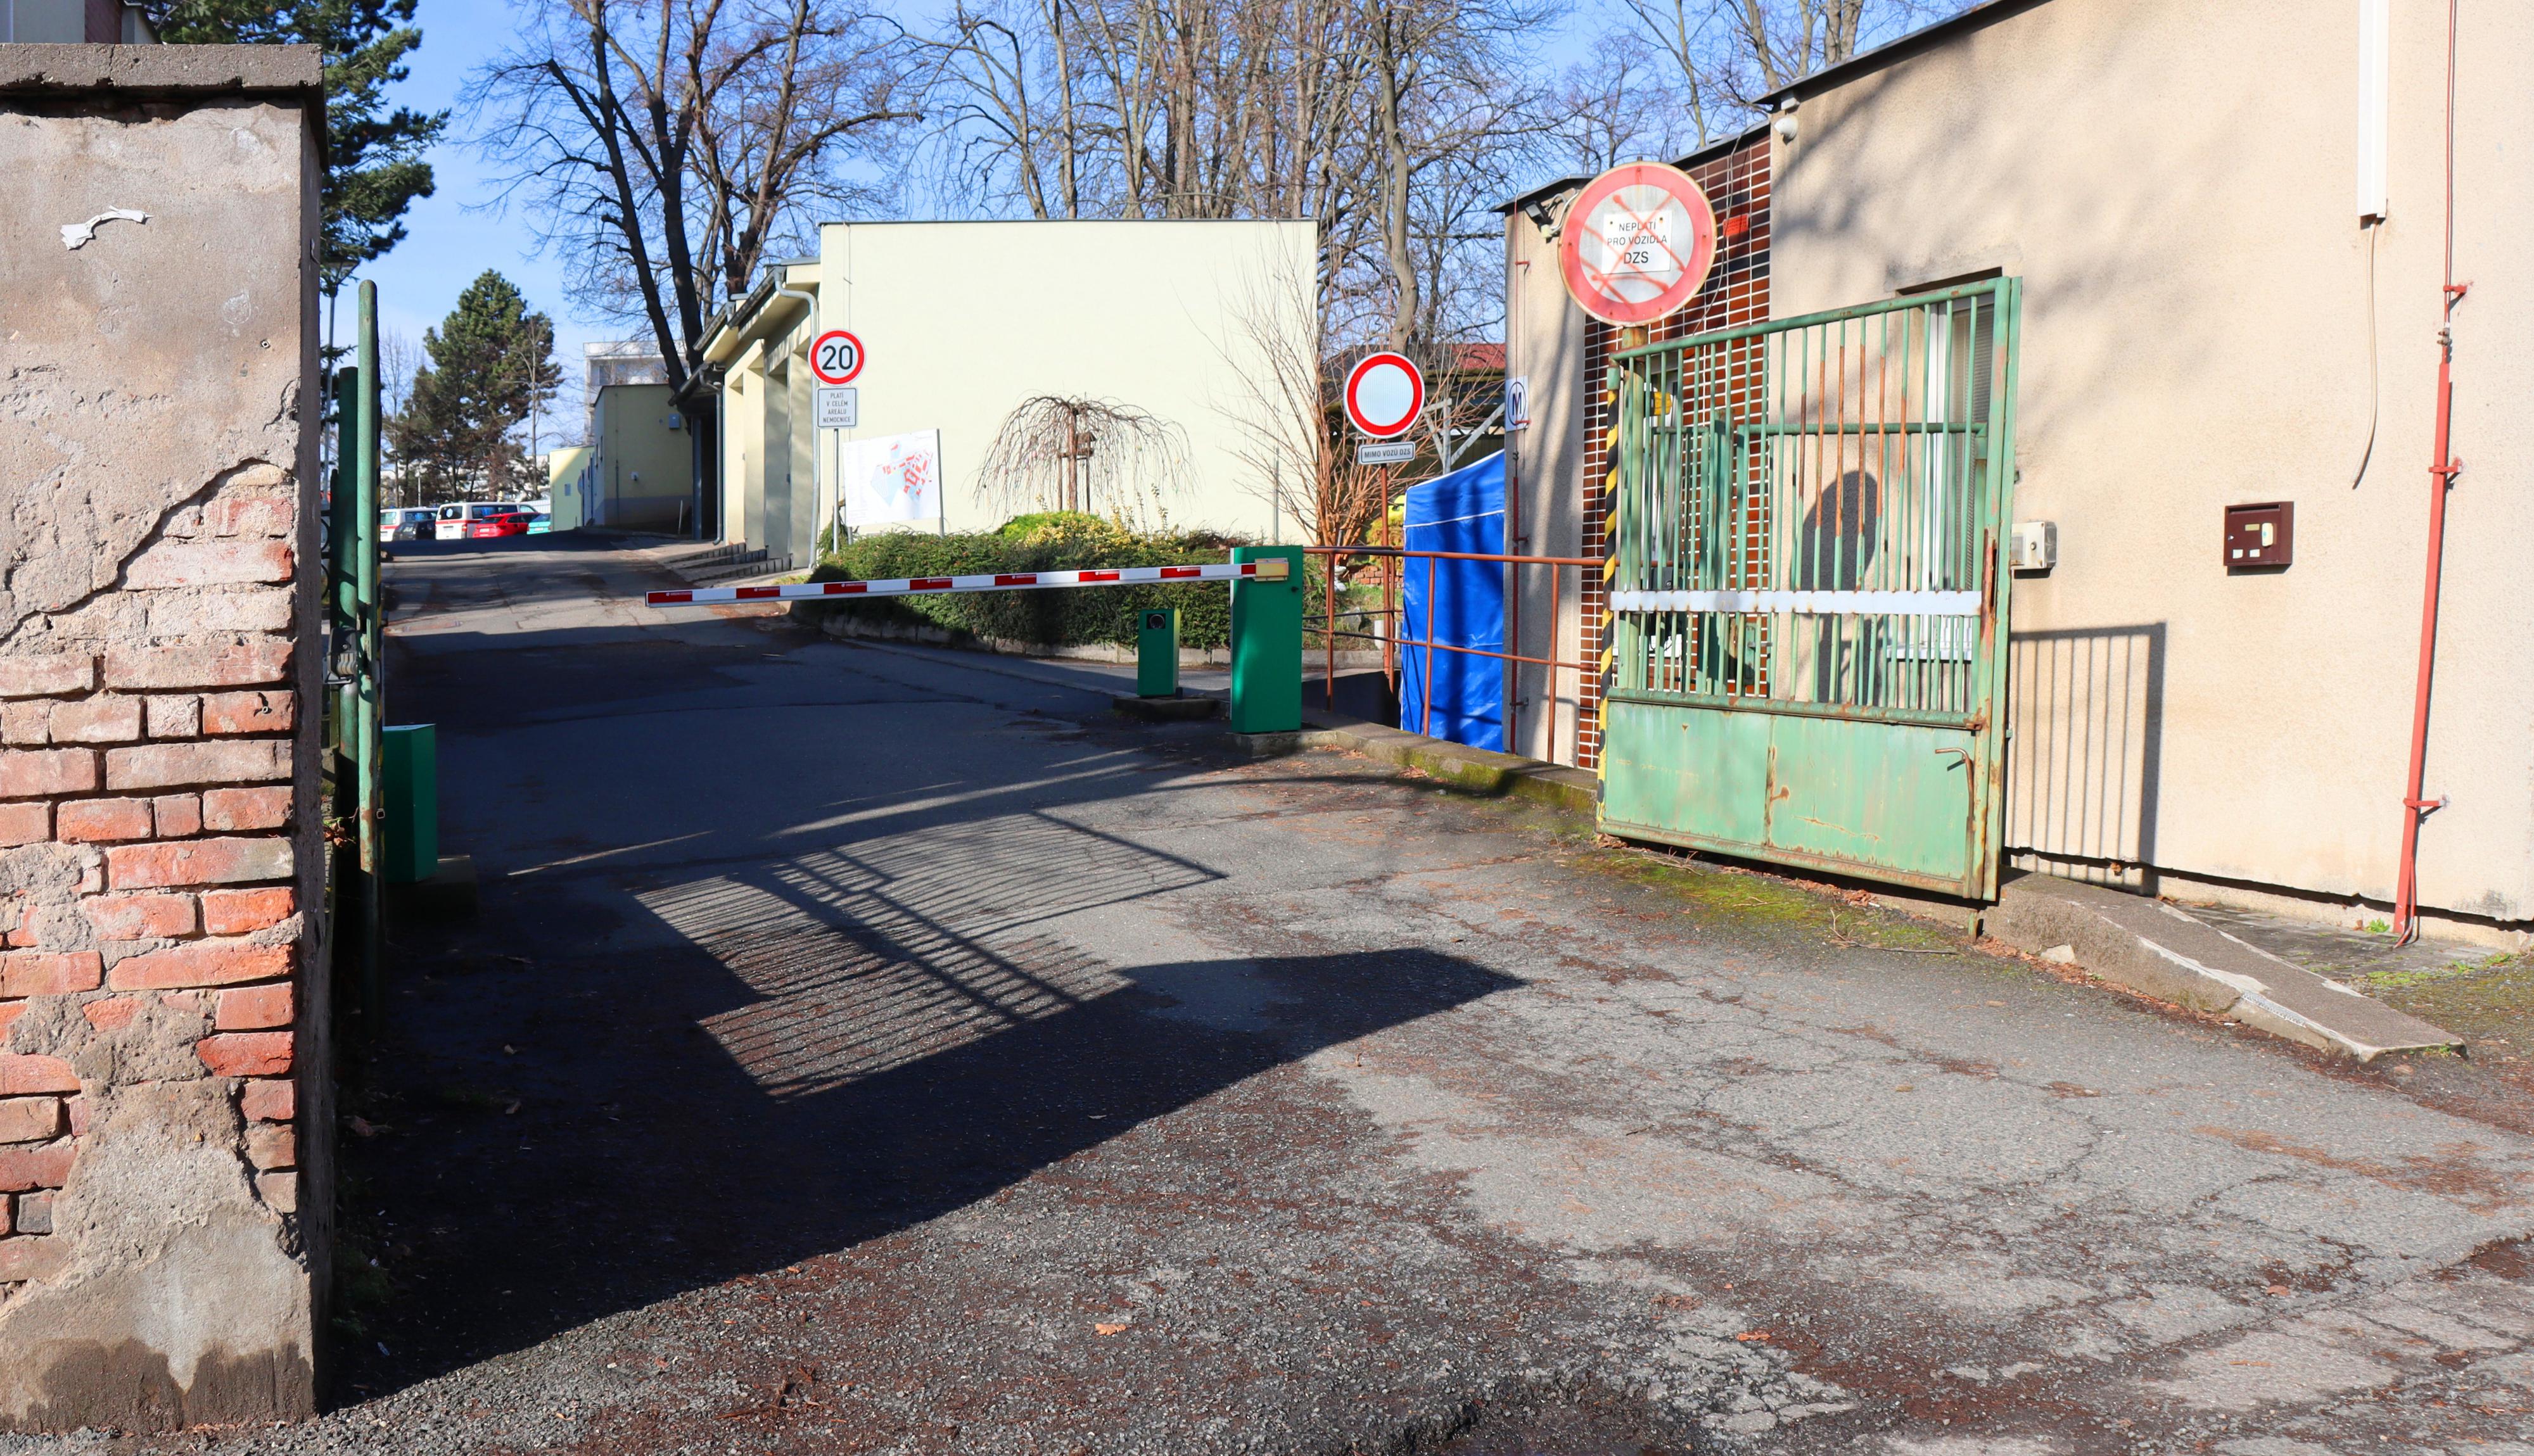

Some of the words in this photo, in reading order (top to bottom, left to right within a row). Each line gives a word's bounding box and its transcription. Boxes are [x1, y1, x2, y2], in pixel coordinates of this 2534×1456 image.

[1607, 237, 1626, 246] PRO
[1629, 235, 1667, 244] VOZIDLA
[1623, 251, 1648, 264] DZS
[822, 345, 853, 370] 20
[1512, 391, 1522, 415] M
